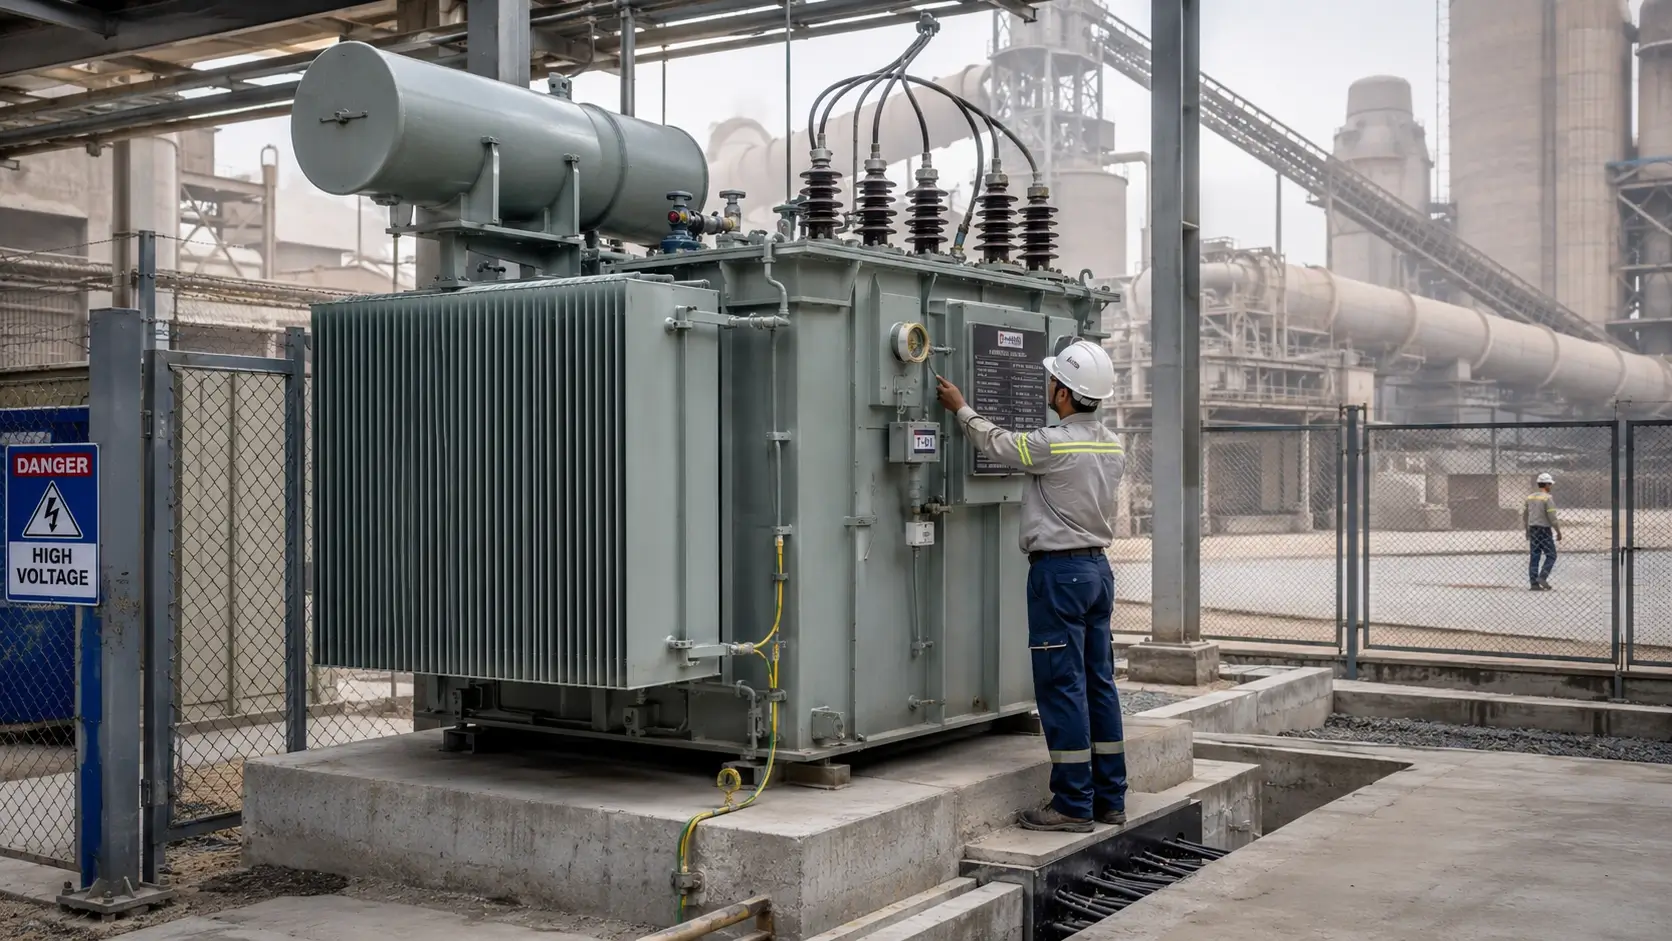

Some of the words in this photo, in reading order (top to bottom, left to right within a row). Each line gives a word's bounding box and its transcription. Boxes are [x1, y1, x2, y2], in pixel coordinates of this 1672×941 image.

[17, 456, 88, 474] DANGER
[32, 547, 72, 565] HIGH
[16, 567, 89, 586] VOLTAGE
